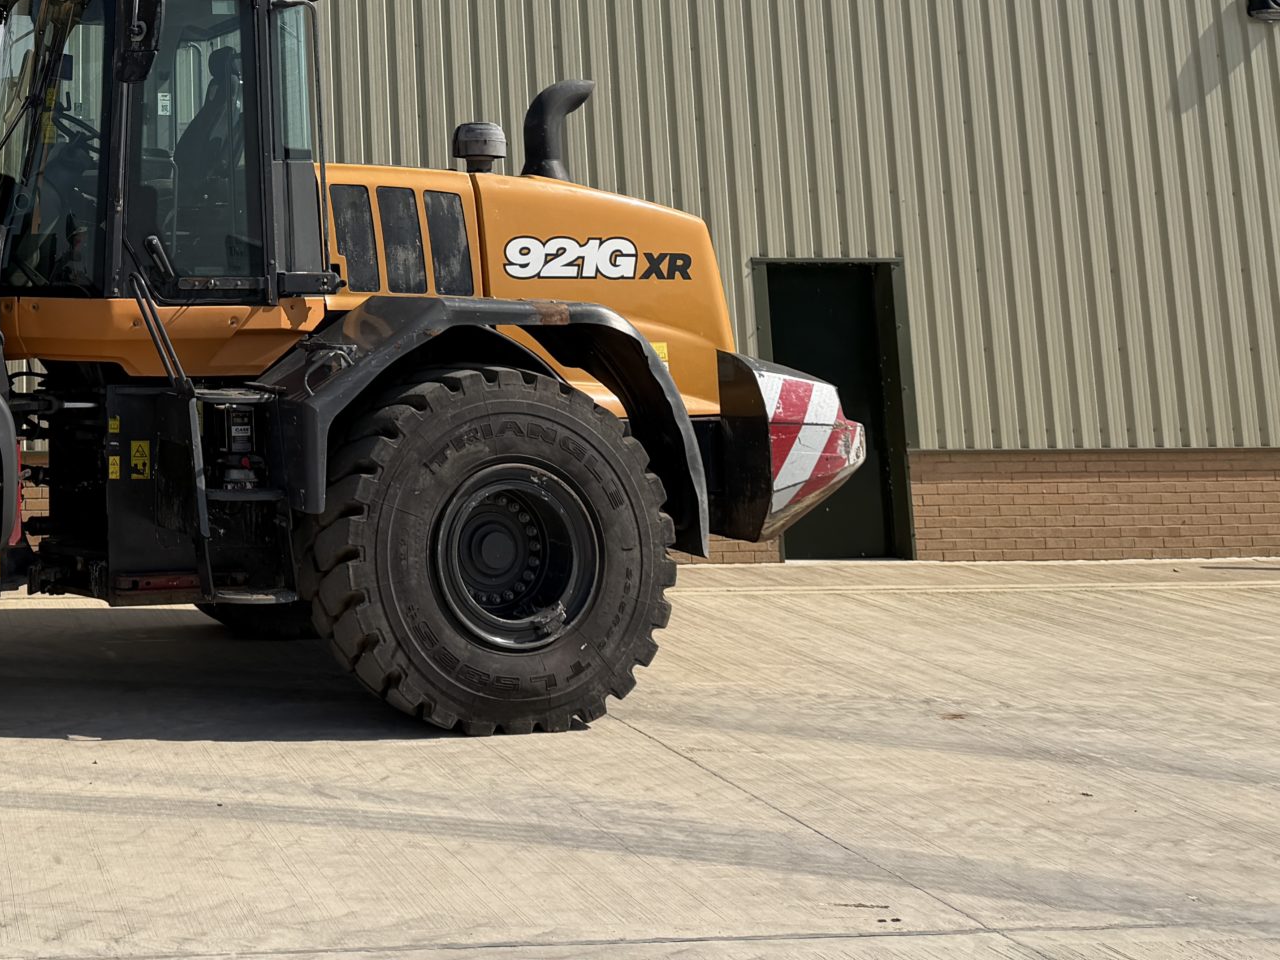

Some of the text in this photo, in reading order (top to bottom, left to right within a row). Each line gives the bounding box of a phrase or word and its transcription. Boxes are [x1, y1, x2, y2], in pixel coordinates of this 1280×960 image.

[503, 235, 692, 280] 921G XR
[423, 419, 625, 511] TRIANGLE
